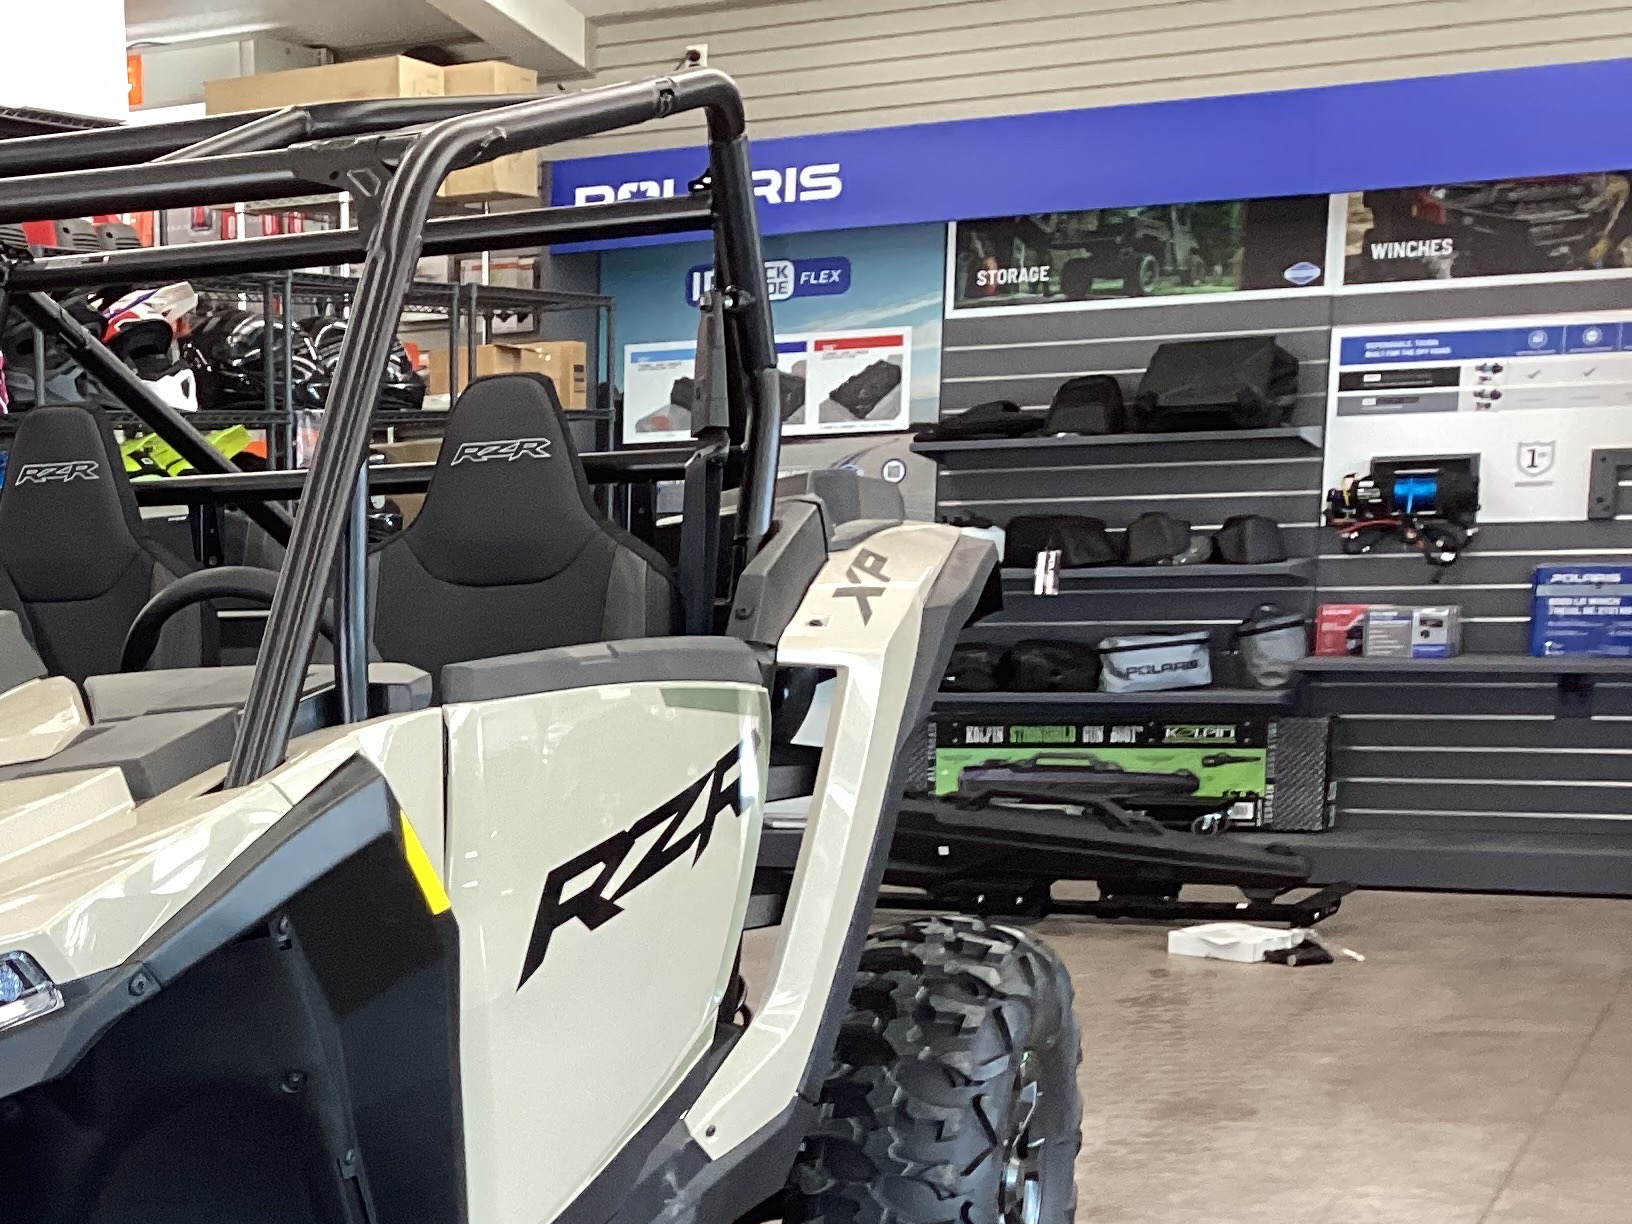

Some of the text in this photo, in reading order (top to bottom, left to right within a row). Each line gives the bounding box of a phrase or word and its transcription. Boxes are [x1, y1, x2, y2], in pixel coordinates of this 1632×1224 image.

[574, 163, 843, 208] PORIS
[1371, 237, 1454, 260] WINCHES
[799, 269, 842, 285] FLEX
[976, 265, 1050, 287] STORAGE
[451, 438, 551, 466] RZR
[14, 461, 99, 486] RZR
[831, 548, 891, 627] XP
[1124, 659, 1199, 681] POLARIS
[515, 730, 760, 993] RZR
